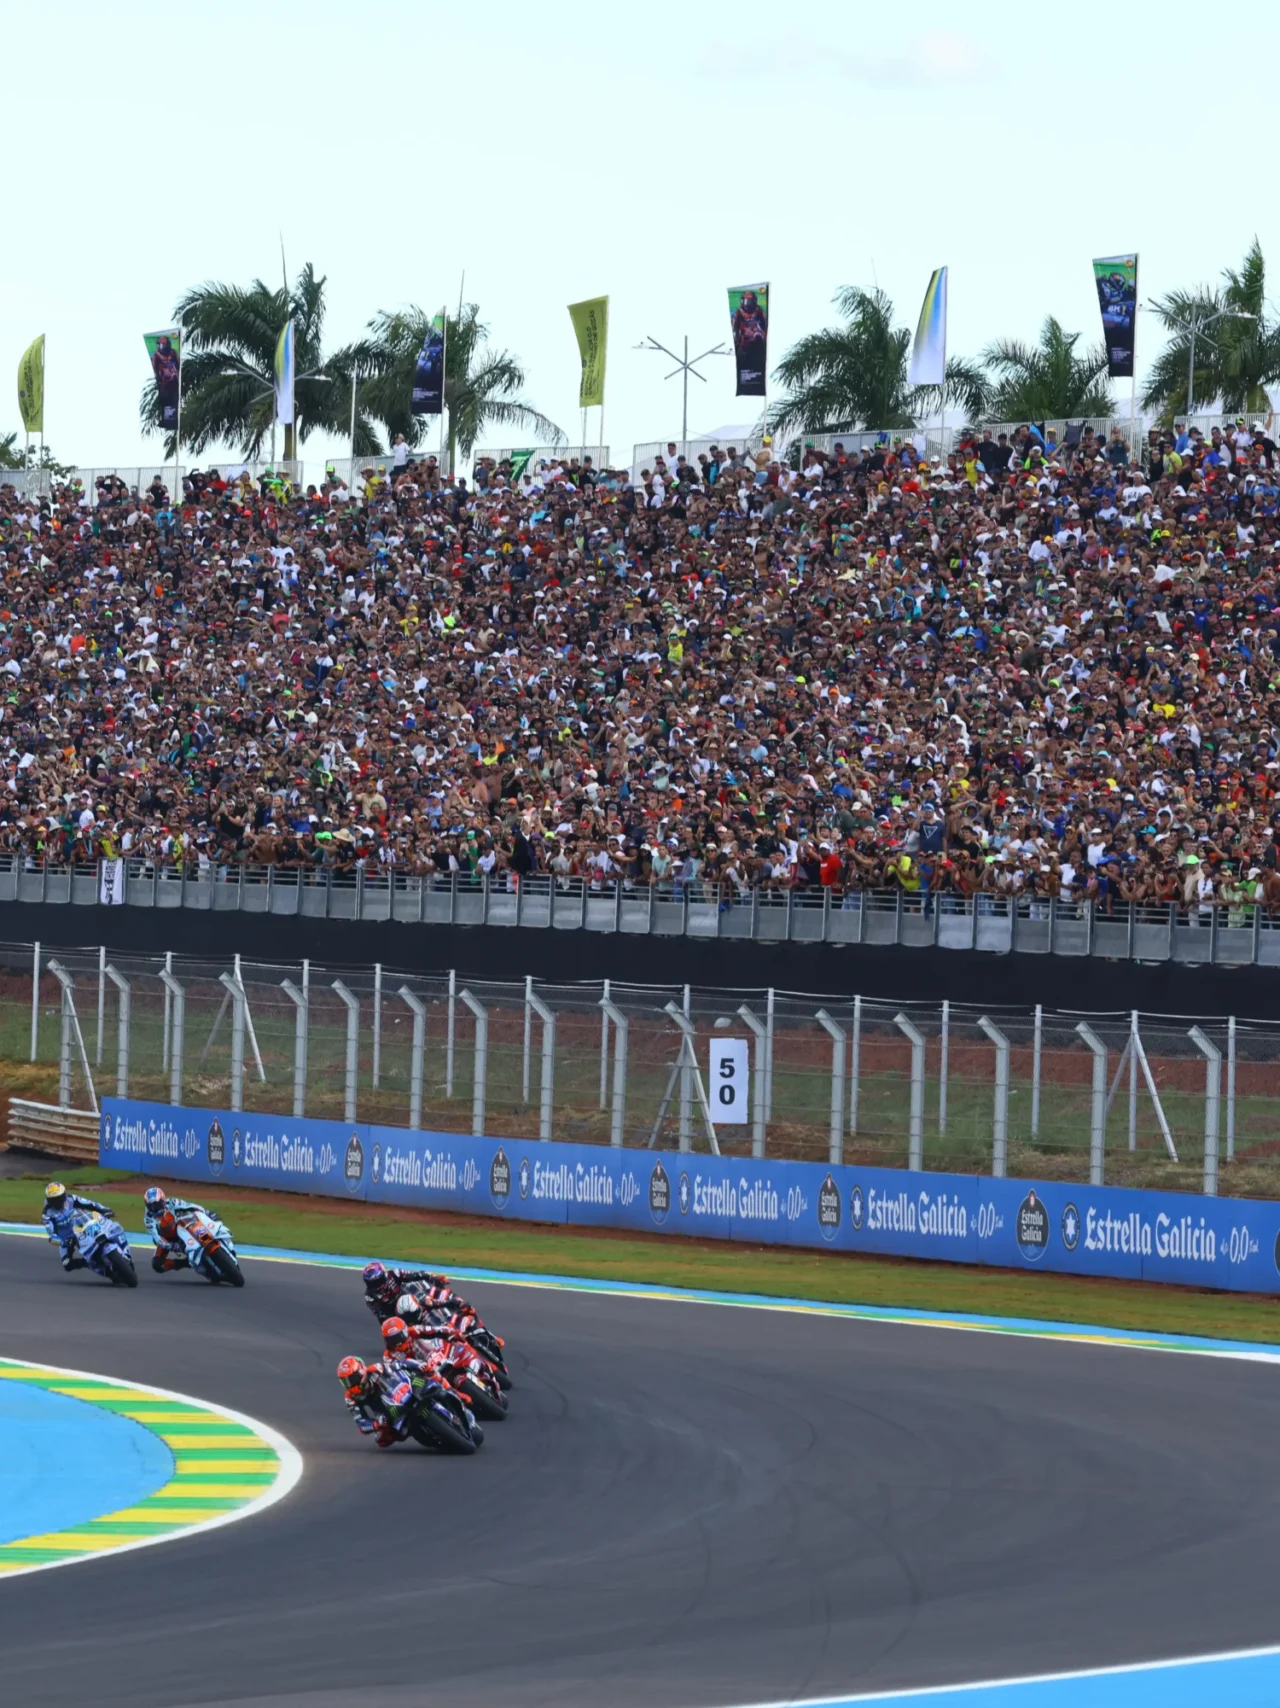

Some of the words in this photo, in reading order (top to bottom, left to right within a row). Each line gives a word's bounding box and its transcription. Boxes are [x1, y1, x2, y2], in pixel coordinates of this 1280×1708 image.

[719, 1058, 735, 1106] 50
[113, 1116, 147, 1153] Estrella
[148, 1119, 179, 1159] Galicia
[244, 1131, 279, 1169] Estrella
[280, 1134, 314, 1174] Galicia
[383, 1145, 421, 1186] Estrella
[422, 1149, 457, 1191] Galicia
[532, 1160, 574, 1200] Estrella
[575, 1162, 614, 1205] Galicia
[692, 1173, 736, 1218] Estrella
[738, 1177, 778, 1221] Galicia
[867, 1187, 916, 1233] Estrella
[918, 1190, 968, 1238] Galicia
[1021, 1208, 1044, 1226] Estrella
[1021, 1225, 1042, 1242] Galicia
[1084, 1206, 1152, 1255] Estrella
[1155, 1212, 1217, 1262] Galicia
